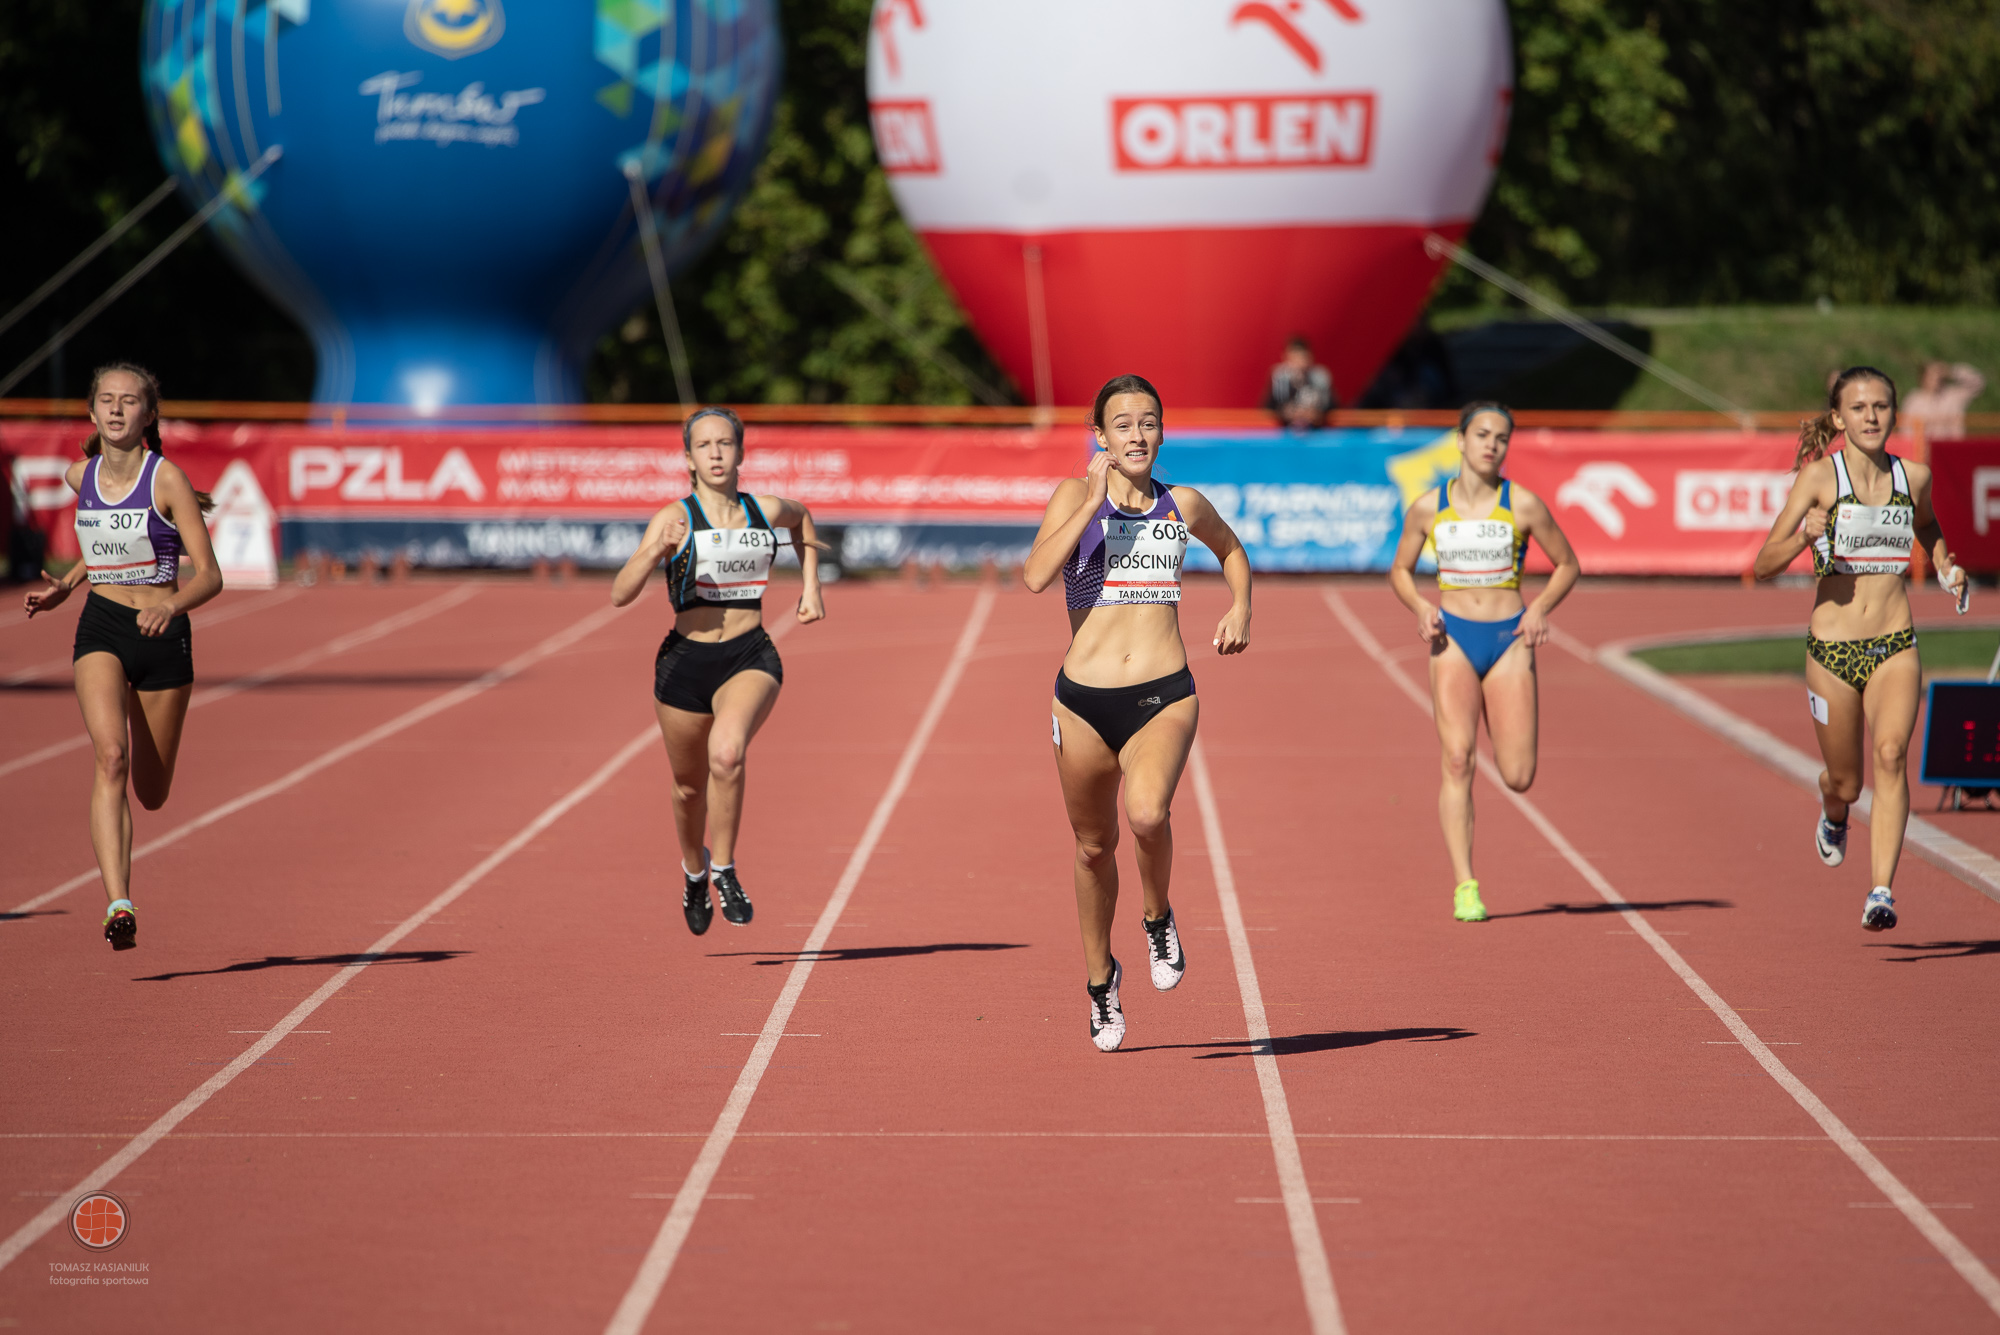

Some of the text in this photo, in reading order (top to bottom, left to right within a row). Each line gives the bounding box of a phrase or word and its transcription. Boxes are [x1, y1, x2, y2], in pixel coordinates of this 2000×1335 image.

[1119, 99, 1369, 167] ORLEN
[289, 446, 486, 501] PZLA
[1691, 485, 1791, 517] ORL
[110, 512, 144, 529] 307
[1881, 510, 1910, 525] 261
[1153, 523, 1187, 541] 608
[1477, 523, 1507, 538] 385
[739, 532, 770, 547] 481
[1837, 534, 1912, 549] MIELCZAREK
[91, 540, 129, 556] ĆWIK
[715, 560, 756, 574] TUCKA
[1107, 551, 1182, 570] GOŚCINIA
[1844, 563, 1898, 573] TARNÓW 2019
[88, 569, 146, 581] TARNÓW 2019
[707, 588, 757, 599] TARNÓW 2019
[1118, 588, 1181, 599] TARNÓW 2019
[1810, 696, 1817, 716] 1
